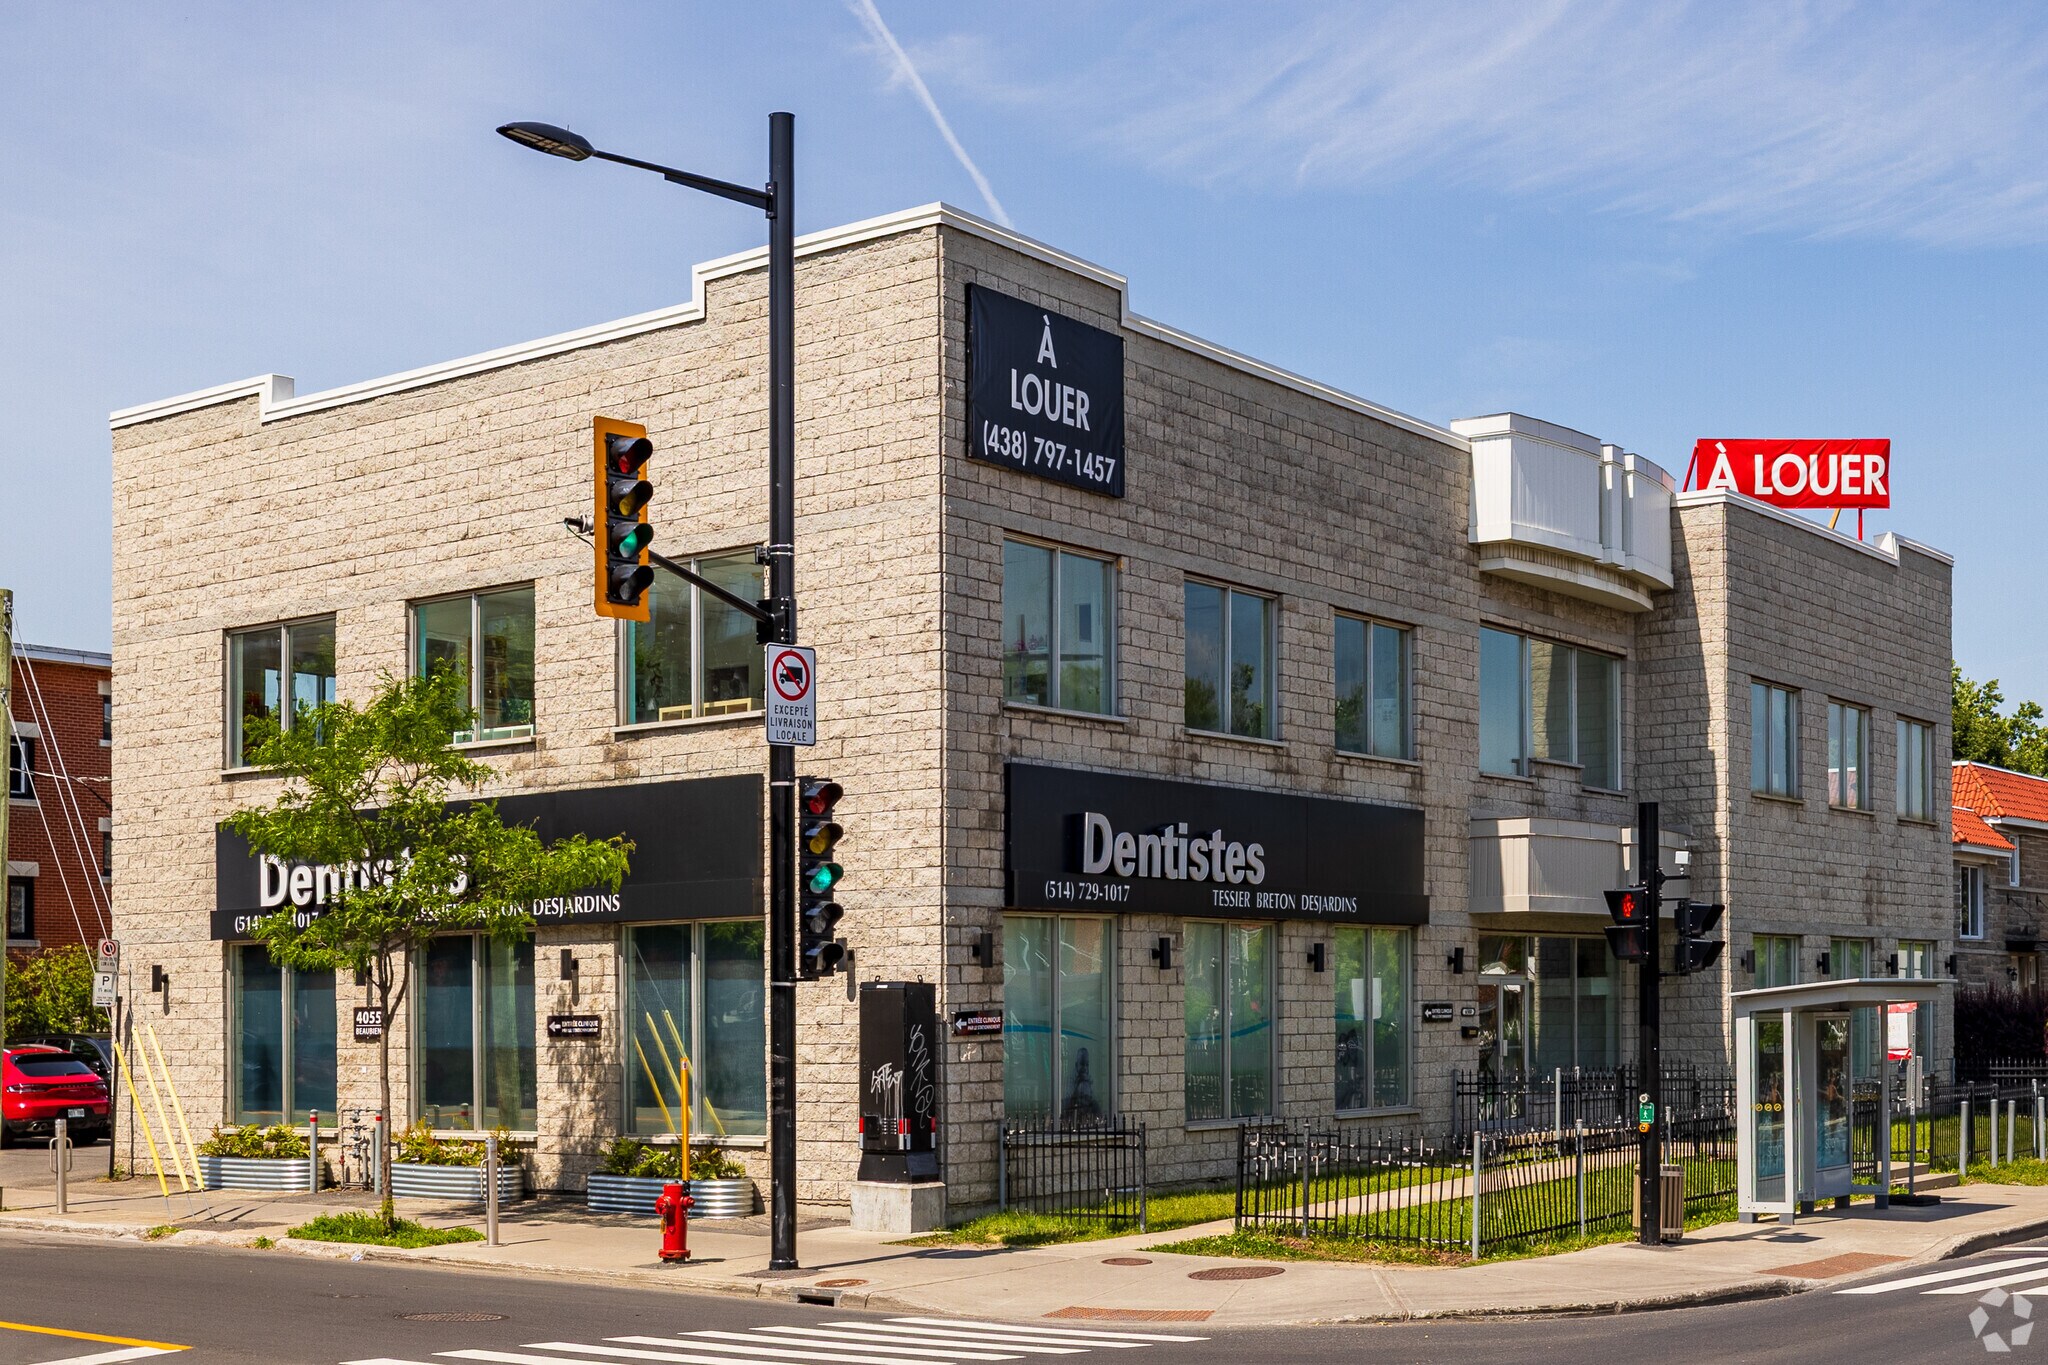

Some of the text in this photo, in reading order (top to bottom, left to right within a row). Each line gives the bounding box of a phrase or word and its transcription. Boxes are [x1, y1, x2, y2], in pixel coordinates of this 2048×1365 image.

[1037, 314, 1057, 369] À
[1011, 368, 1090, 432] LOUER
[983, 419, 1115, 484] (438) 797-1457
[1706, 441, 1887, 496] À LOUER
[774, 704, 809, 716] EXCEPTÉ
[770, 717, 812, 729] LIVRAISON
[776, 730, 807, 741] LOCALE
[1083, 811, 1265, 885] Dentistes
[1044, 880, 1131, 902] (514) 729-1017
[1212, 889, 1357, 914] TESSIER BRETON DESJARDINS
[533, 894, 620, 917] DESJARDINS
[102, 976, 110, 986] P
[356, 1011, 381, 1024] 4055
[355, 1027, 382, 1035] BEAUBIEN
